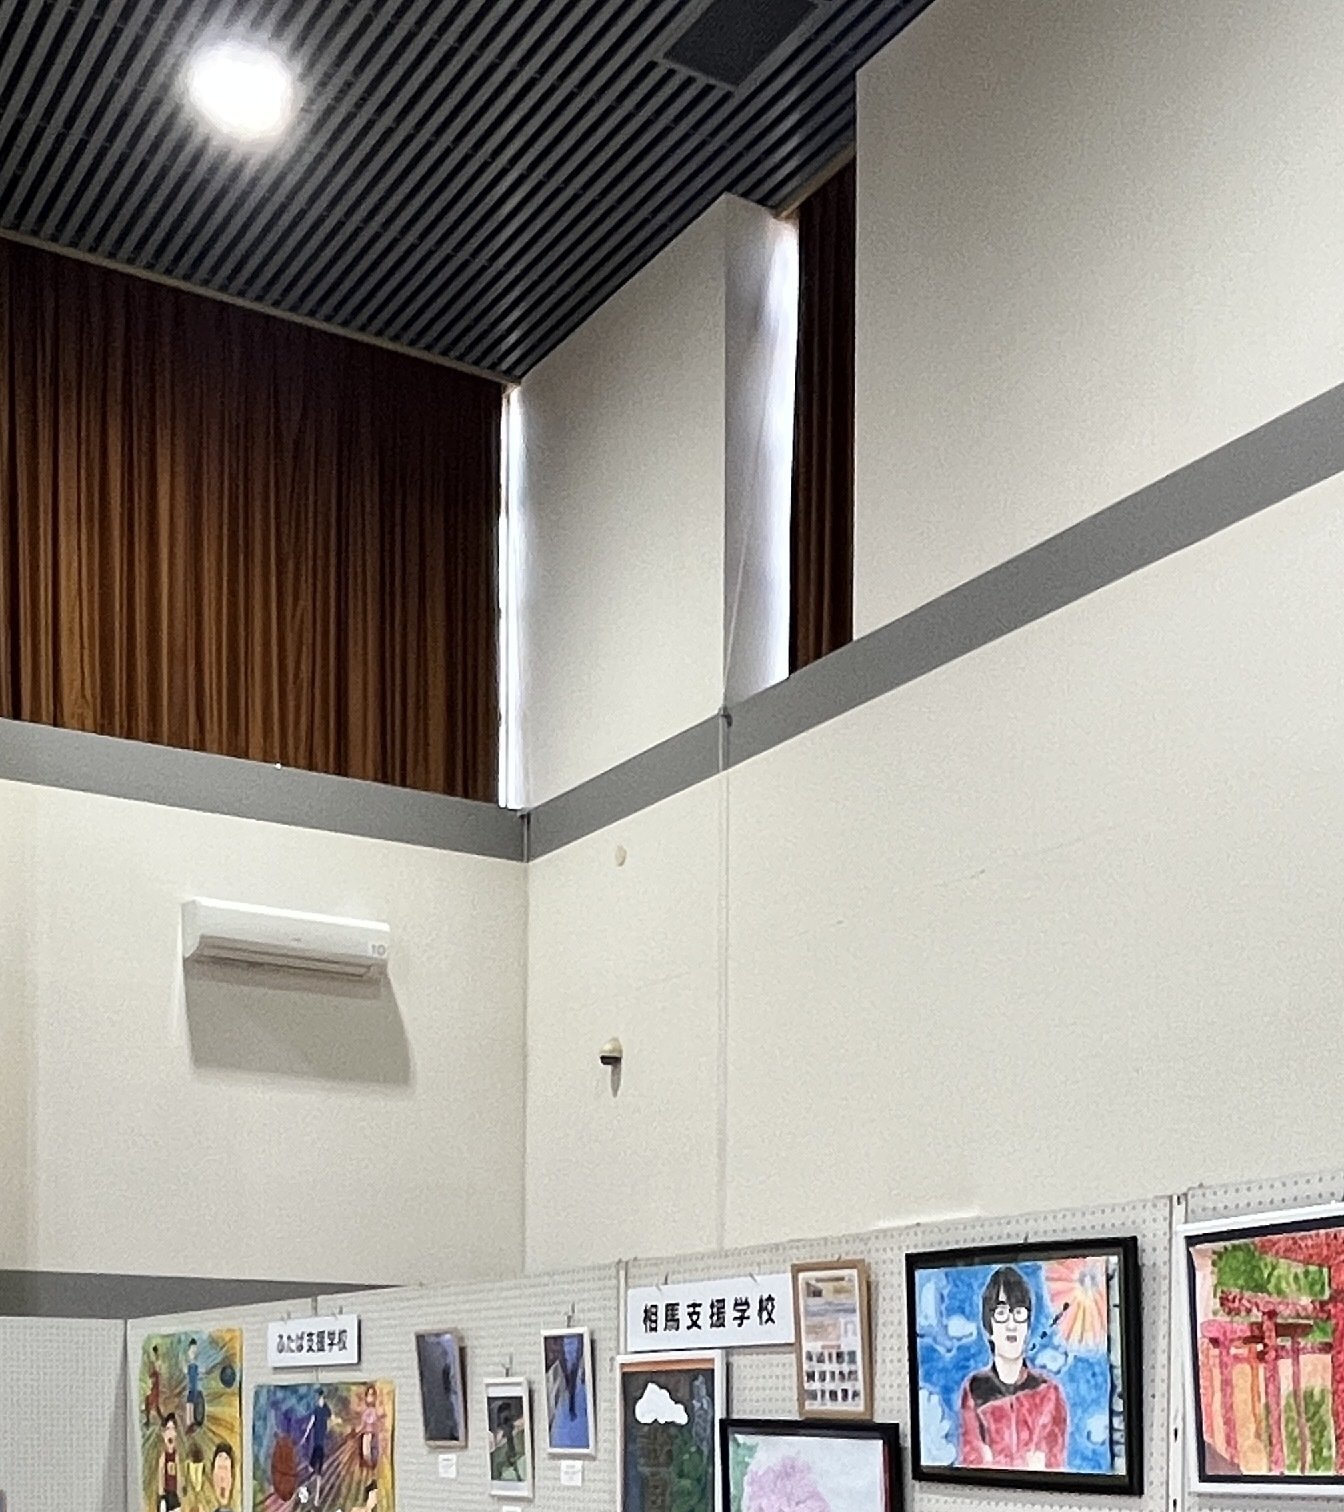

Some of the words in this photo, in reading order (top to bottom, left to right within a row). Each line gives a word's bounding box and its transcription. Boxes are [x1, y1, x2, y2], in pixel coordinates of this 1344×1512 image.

[642, 1293, 776, 1334] 相馬支援学校
[276, 1328, 348, 1354] ふたば支援学校
